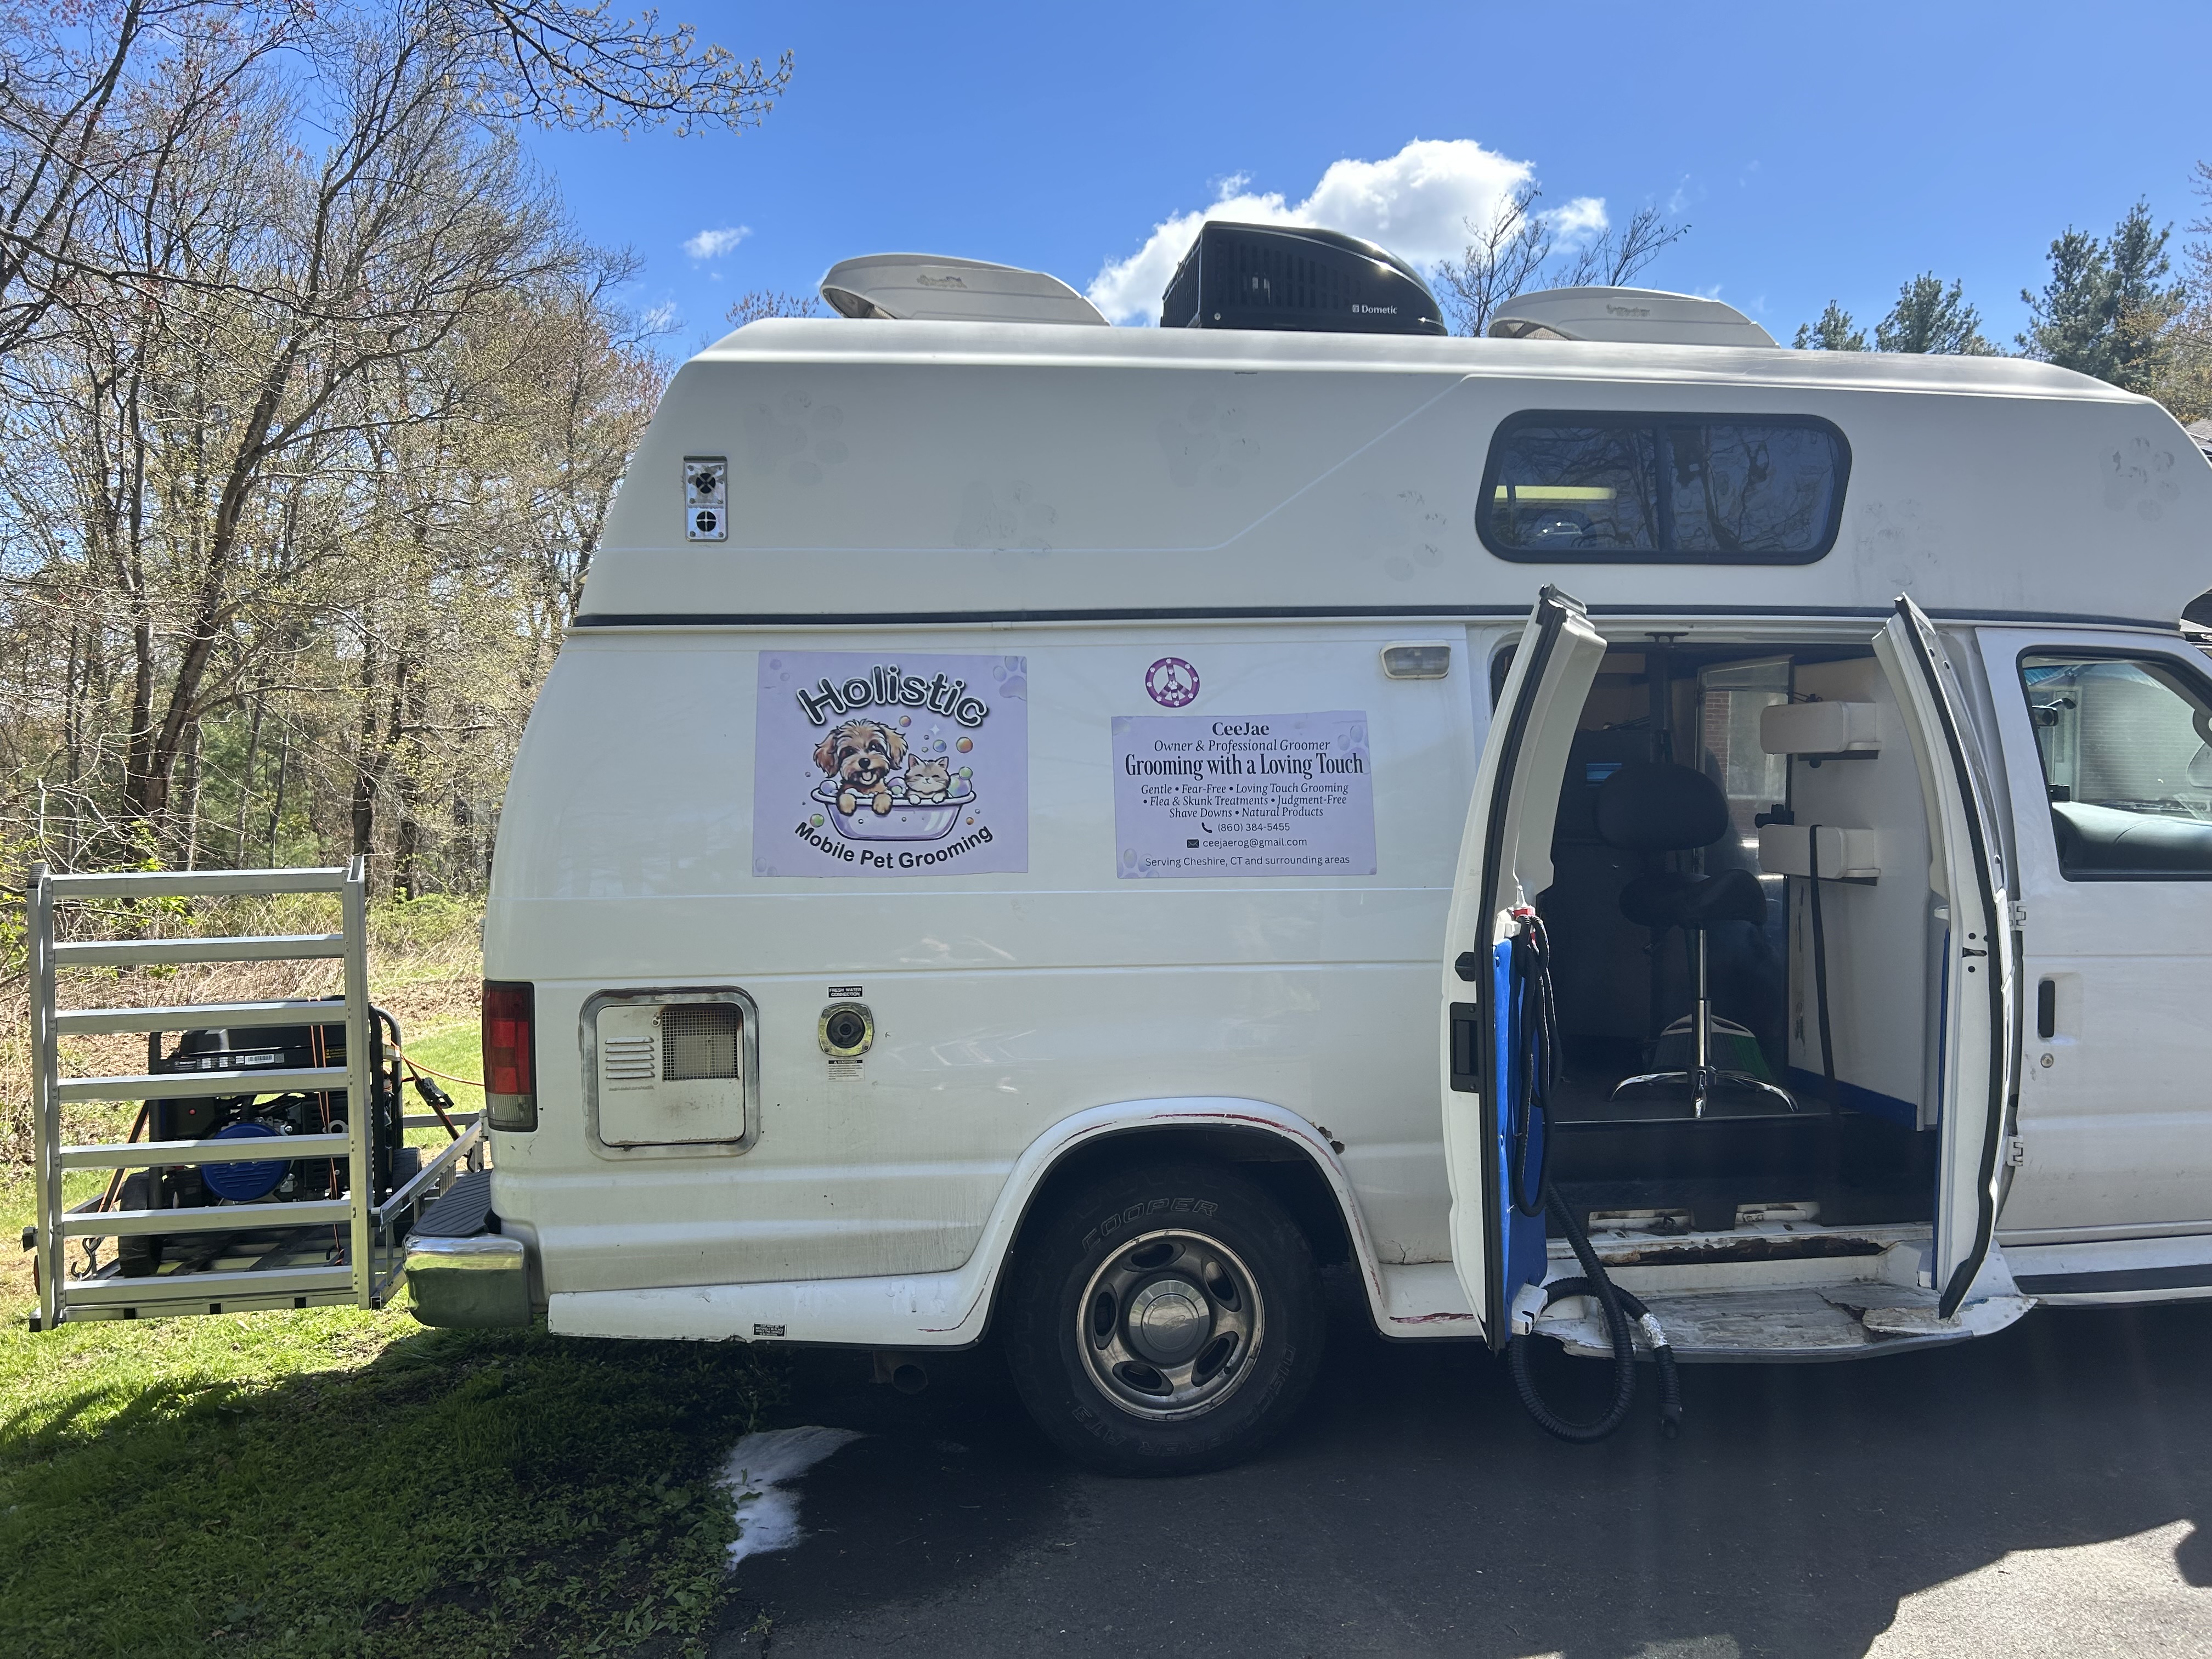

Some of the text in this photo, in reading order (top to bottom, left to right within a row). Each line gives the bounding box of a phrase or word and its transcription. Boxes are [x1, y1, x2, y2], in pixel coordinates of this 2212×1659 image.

[1362, 304, 1398, 314] Dometic
[797, 664, 988, 727] Holistic
[1212, 722, 1269, 736] CeeJae
[1155, 739, 1330, 754] Owner & Professional Groomer
[1126, 753, 1363, 781] Grooming with a Loving Touch
[1141, 782, 1348, 795] Gentle Fear-Free Loving Touch Grooming
[1150, 794, 1346, 807] Flea & Skunk Treatments Judgment-Free
[1170, 806, 1323, 818] Shave Downs Natural Products
[1218, 823, 1290, 832] (860) 384-5455
[795, 822, 994, 869] Mobile Pet Grooming
[1203, 838, 1307, 849] ceejaerog@gmail.com
[1146, 857, 1181, 868] Serving
[1184, 857, 1227, 867] Cheshire,
[1245, 856, 1262, 865] and
[1266, 856, 1323, 866] surrounding
[1082, 1198, 1218, 1254] COOPER
[1138, 1343, 1296, 1457] DISCOVERER
